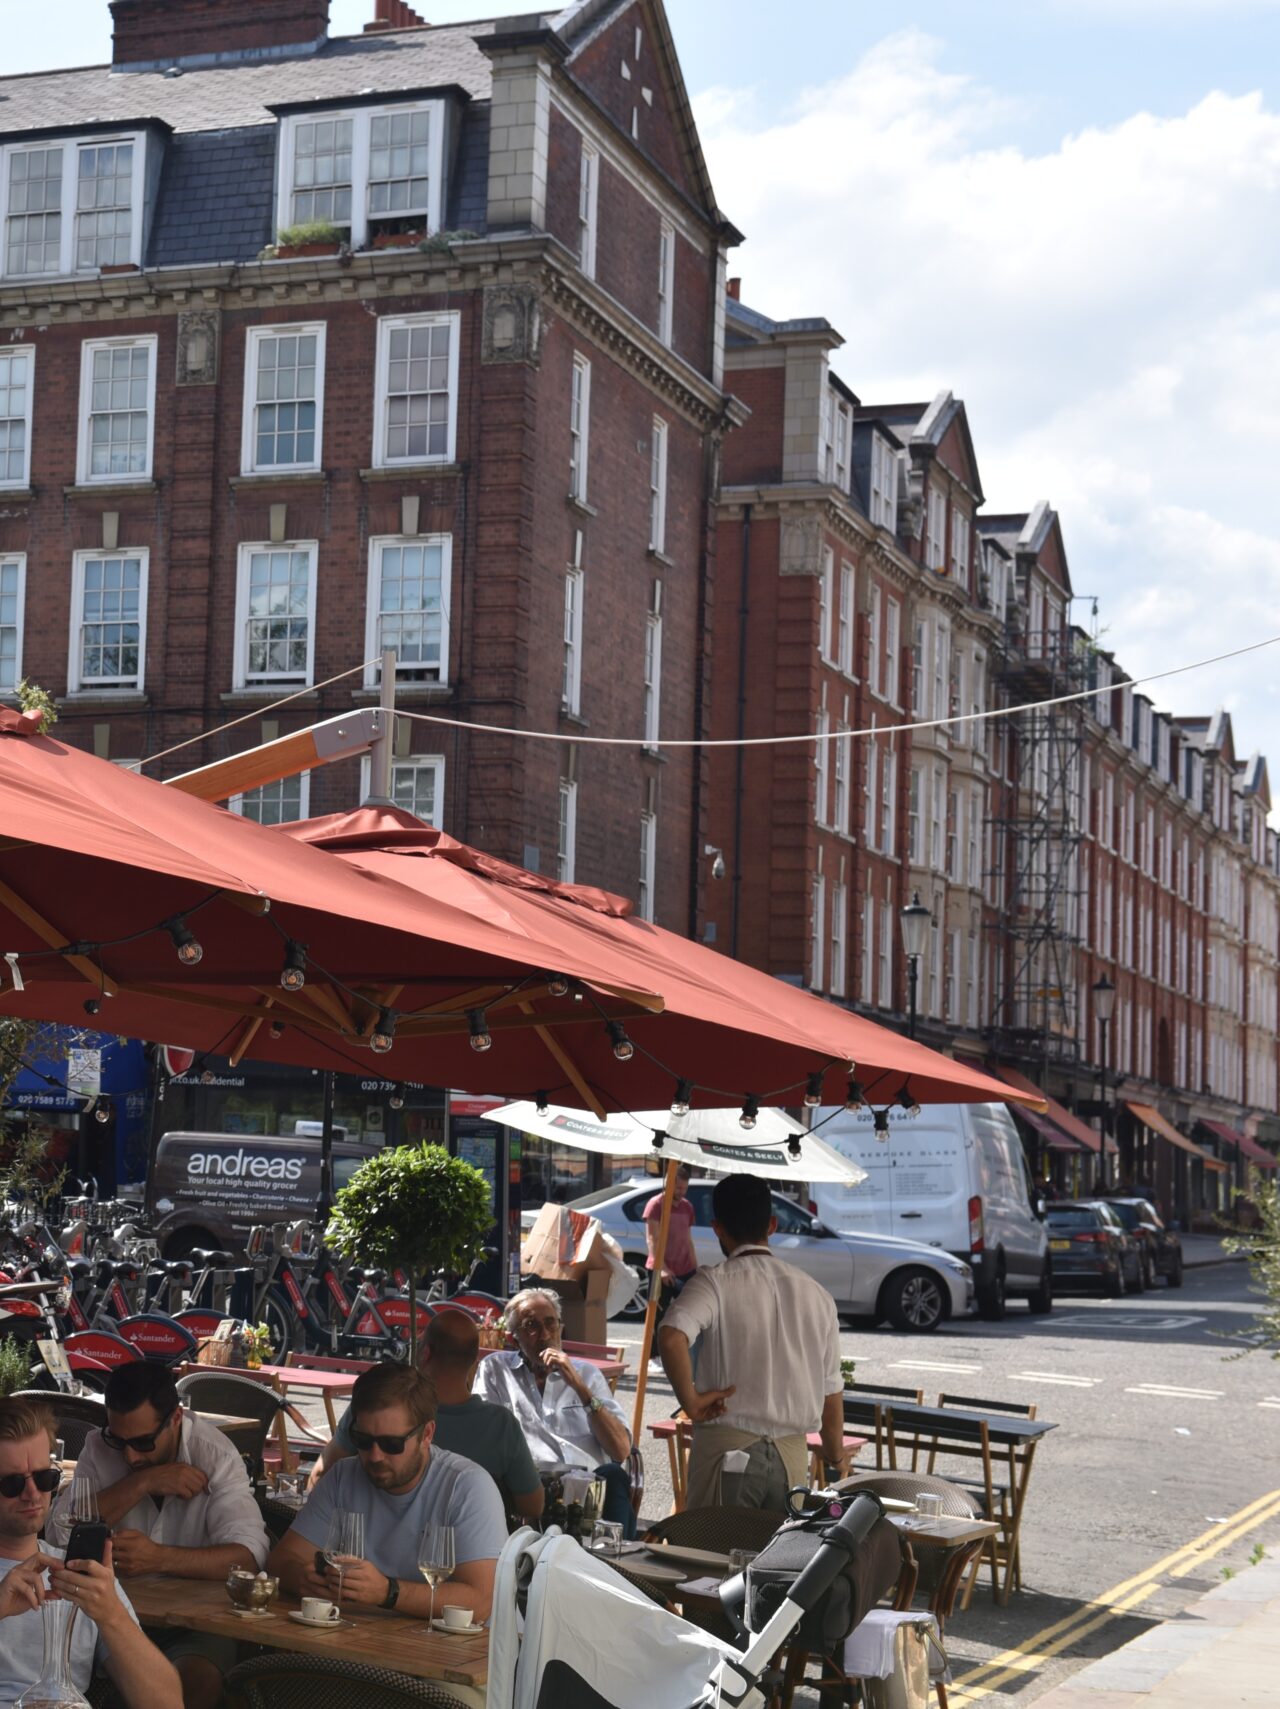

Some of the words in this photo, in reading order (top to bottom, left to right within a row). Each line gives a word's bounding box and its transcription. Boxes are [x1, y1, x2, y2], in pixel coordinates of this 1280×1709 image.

[361, 1081, 378, 1090] 020
[713, 1145, 746, 1157] COATES
[755, 1152, 783, 1161] SEELY
[187, 1149, 302, 1180] andreas
[187, 1176, 204, 1184] Your
[206, 1176, 224, 1185] local
[225, 1177, 242, 1188] high
[244, 1178, 271, 1190] quality
[272, 1182, 297, 1190] grocer
[229, 1201, 248, 1209] Freshly
[139, 1332, 175, 1343] Santander
[194, 1327, 216, 1336] Santa
[83, 1347, 122, 1360] Santander
